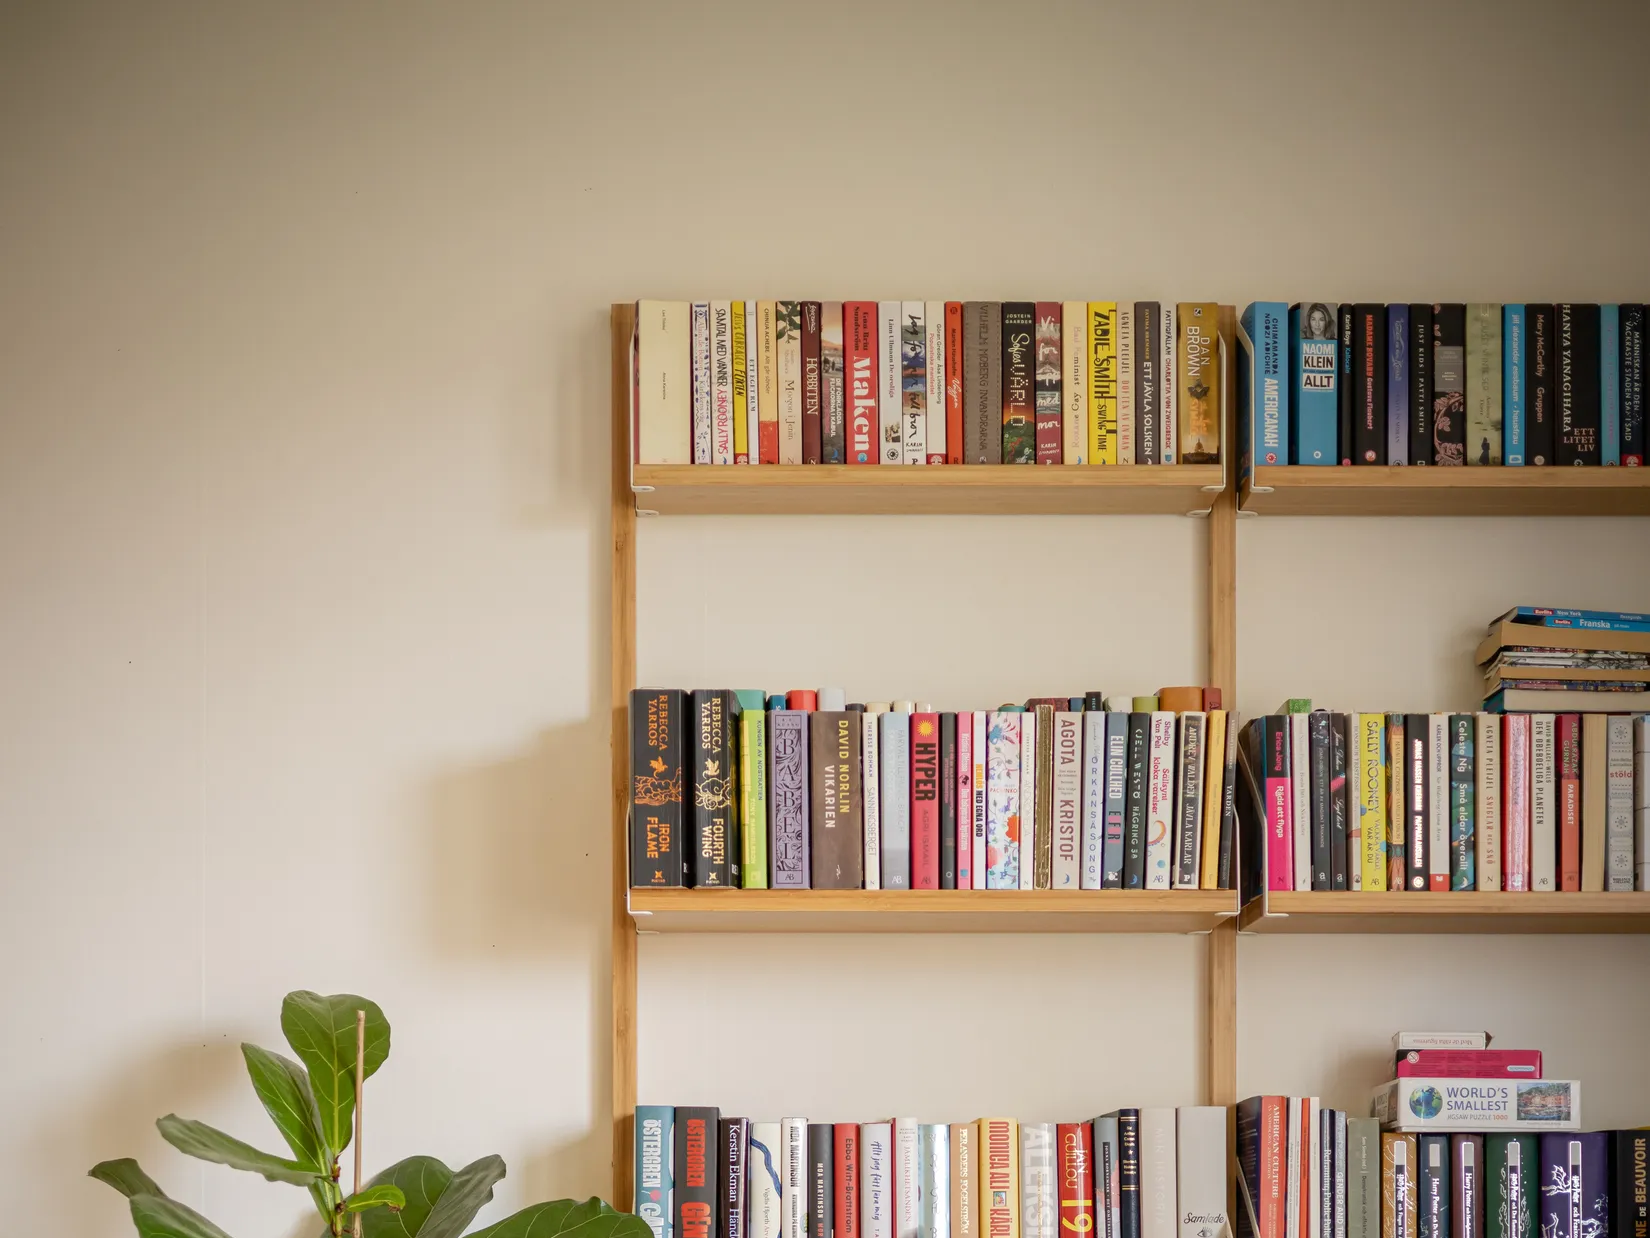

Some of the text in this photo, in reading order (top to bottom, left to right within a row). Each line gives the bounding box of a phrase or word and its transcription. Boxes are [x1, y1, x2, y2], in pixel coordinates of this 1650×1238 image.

[715, 308, 727, 356] SAMTAL MED
[1121, 312, 1129, 340] AGNETA
[1187, 326, 1200, 376] BROWN
[1201, 337, 1210, 365] DAN
[1303, 344, 1334, 355] NAOMI
[1304, 356, 1334, 369] KLEIN
[1535, 314, 1545, 423] Mary McCarthy Gruppen
[1563, 304, 1572, 432] HANYA YANAGIHARA
[806, 357, 818, 415] HOBBITEN
[979, 305, 988, 450] VILHELM MOBERG INVANDRARNA
[1008, 333, 1030, 426] Sofies VÄRLD
[1094, 311, 1115, 452] ZADIE SMITH SWING TIME
[1304, 375, 1333, 387] ALLT
[717, 389, 729, 455] SALLY ROONEY
[853, 356, 876, 451] Maken
[1143, 362, 1154, 455] ETT JÄVLA SOLSKEN
[1264, 378, 1279, 447] AMERICANAH
[1580, 619, 1610, 629] Franska
[648, 700, 658, 746] YARROS
[659, 694, 668, 750] REBECCA
[701, 702, 711, 749] YARROS
[711, 697, 721, 754] REBECCA
[1060, 719, 1075, 765] AGOTA
[1162, 721, 1171, 746] Shelby
[1535, 721, 1543, 735] DEN
[838, 720, 849, 813] DAVID NORLIN
[915, 743, 936, 801] HYPER
[1109, 735, 1124, 799] ELIN CULLHED
[1161, 768, 1170, 801] Sällsynt
[1274, 752, 1283, 771] Jong
[1367, 721, 1379, 814] SALLY ROONEY
[825, 765, 835, 828] VIKARIEN
[1152, 782, 1160, 814] varelser
[1225, 785, 1233, 817] YARDEN
[1275, 786, 1284, 805] Rädd
[1457, 758, 1468, 870] Ng Små eldar överallt
[1536, 787, 1544, 825] PLANETEN
[646, 816, 658, 858] FLAME
[659, 824, 670, 852] IRON
[702, 825, 712, 858] WING
[712, 818, 724, 864] FOURTH
[866, 787, 876, 856] SANNINGSBERGET
[976, 823, 984, 837] ORD
[1060, 800, 1074, 861] KRISTOF
[1184, 803, 1197, 864] JÄVLA KARLAR
[1275, 819, 1285, 838] flyga
[1447, 1087, 1508, 1098] WORLD'S
[1447, 1101, 1508, 1111] SMALLEST
[729, 1124, 740, 1161] Kerstin
[845, 1138, 854, 1160] Ebba
[989, 1121, 1010, 1169] MONICA
[1272, 1104, 1280, 1153] AMERICAN
[641, 1119, 661, 1187] ÖSTERGREN
[790, 1126, 800, 1187] MOA MARTINSON
[1065, 1133, 1078, 1188] GUILLOU
[1077, 1149, 1089, 1174] JAN
[1322, 1149, 1332, 1191] Reframing
[1634, 1138, 1647, 1202] BEAUVOIR
[729, 1165, 740, 1202] Ekman
[845, 1164, 855, 1233] Witt-Brattström
[990, 1172, 1010, 1189] ALI
[1272, 1155, 1280, 1198] CULTURE
[1336, 1172, 1344, 1203] GENDER
[1184, 1212, 1225, 1224] Samlade
[1323, 1192, 1332, 1217] Public
[1336, 1204, 1344, 1223] AND
[1640, 1206, 1647, 1217] DE
